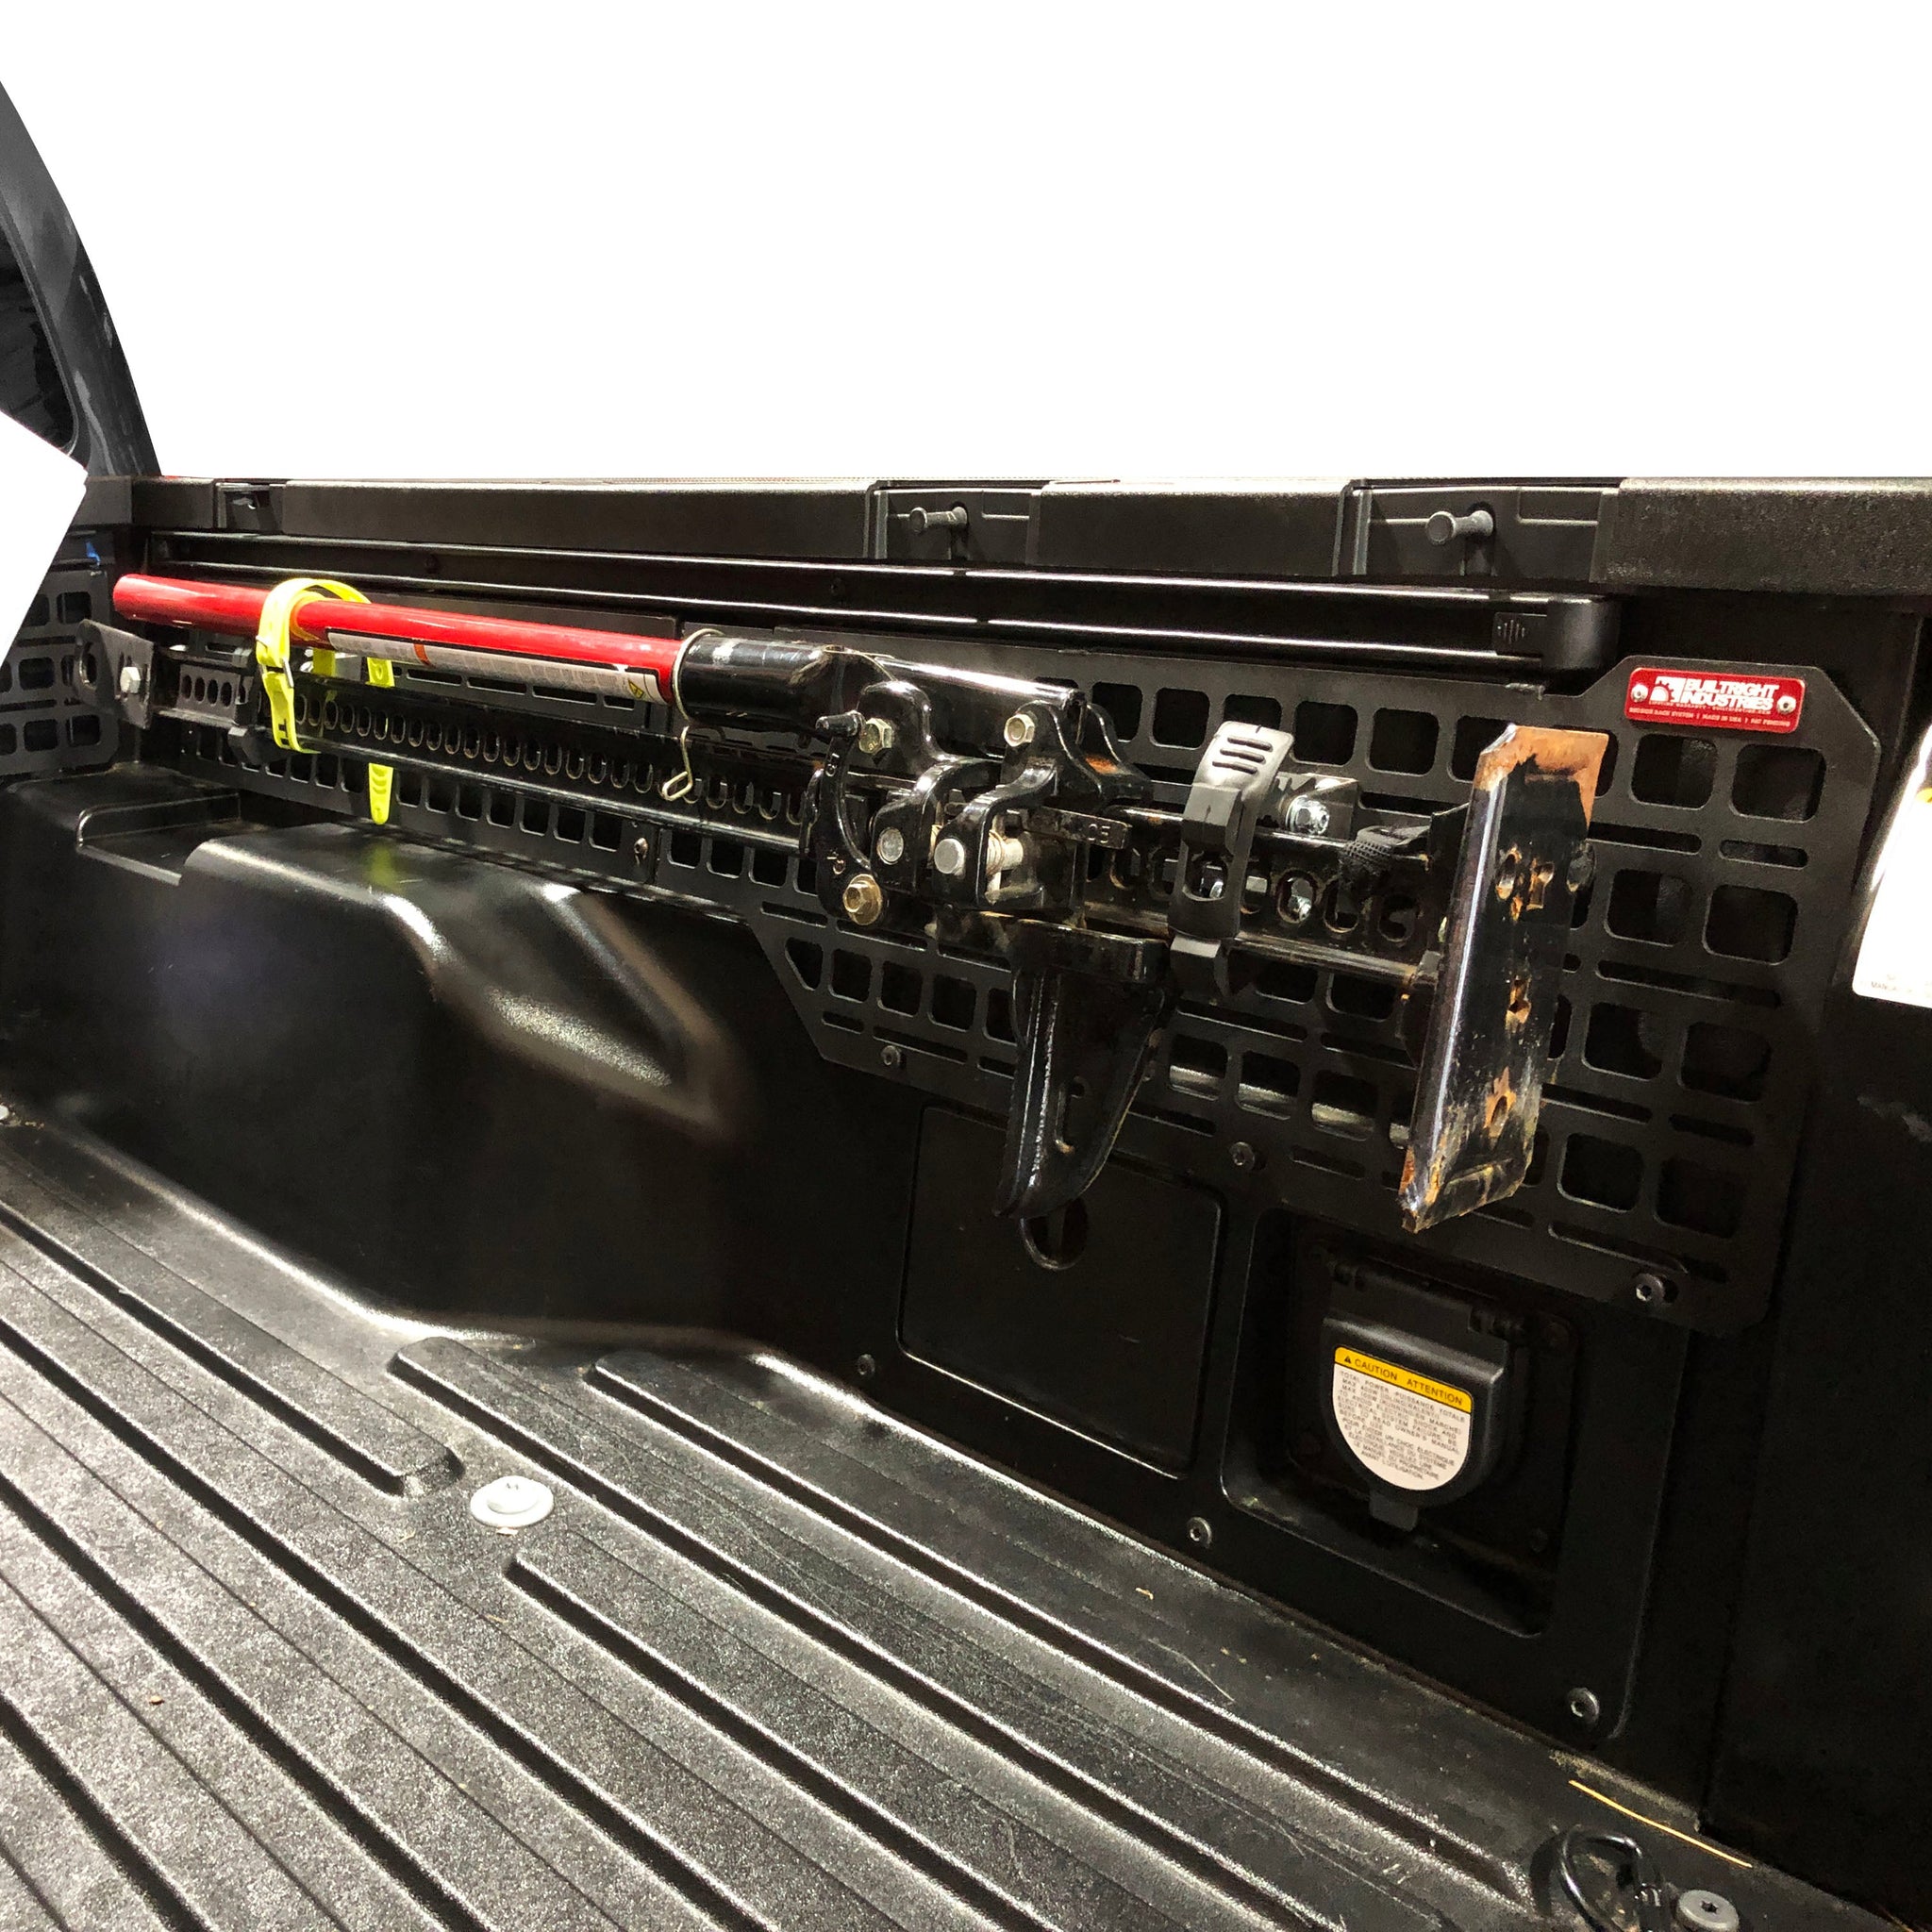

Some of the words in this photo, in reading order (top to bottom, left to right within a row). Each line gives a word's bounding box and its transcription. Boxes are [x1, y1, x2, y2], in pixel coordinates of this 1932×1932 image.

[1680, 691, 1774, 711] INDUSTRIES
[1342, 1378, 1356, 1388] MAX
[1355, 1358, 1398, 1381] CAUTION
[1407, 1378, 1463, 1407] ATTENTION
[1365, 1380, 1389, 1393] POWER
[1342, 1385, 1356, 1394] MAX
[1442, 1429, 1457, 1440] AND
